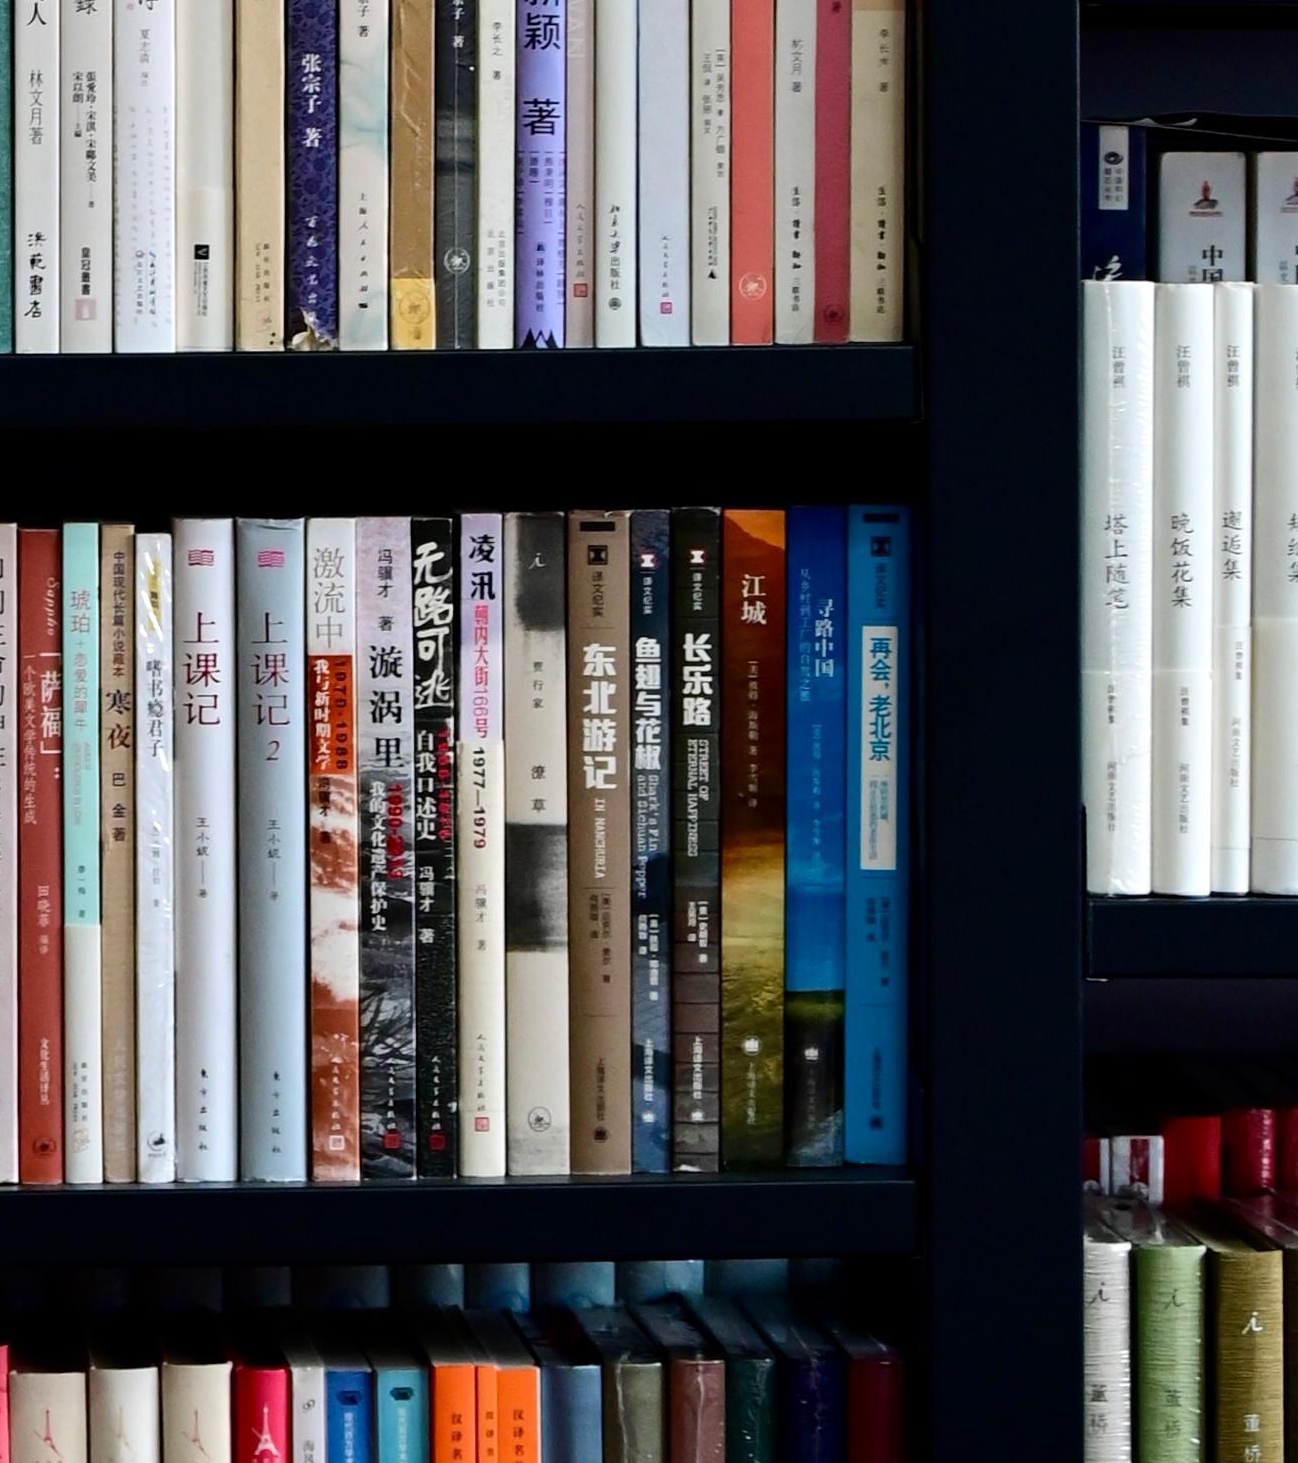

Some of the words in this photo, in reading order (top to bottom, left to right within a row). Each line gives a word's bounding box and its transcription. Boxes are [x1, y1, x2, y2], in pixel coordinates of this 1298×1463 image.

[741, 573, 767, 625] 江城
[1171, 512, 1194, 609] 晚饭花集
[185, 611, 220, 726] 上课记
[254, 611, 289, 726] 上课记
[582, 642, 617, 790] 东北游记
[634, 636, 662, 771] 鱼翅与花椒
[682, 632, 713, 727] 长乐路
[266, 740, 281, 762] 2
